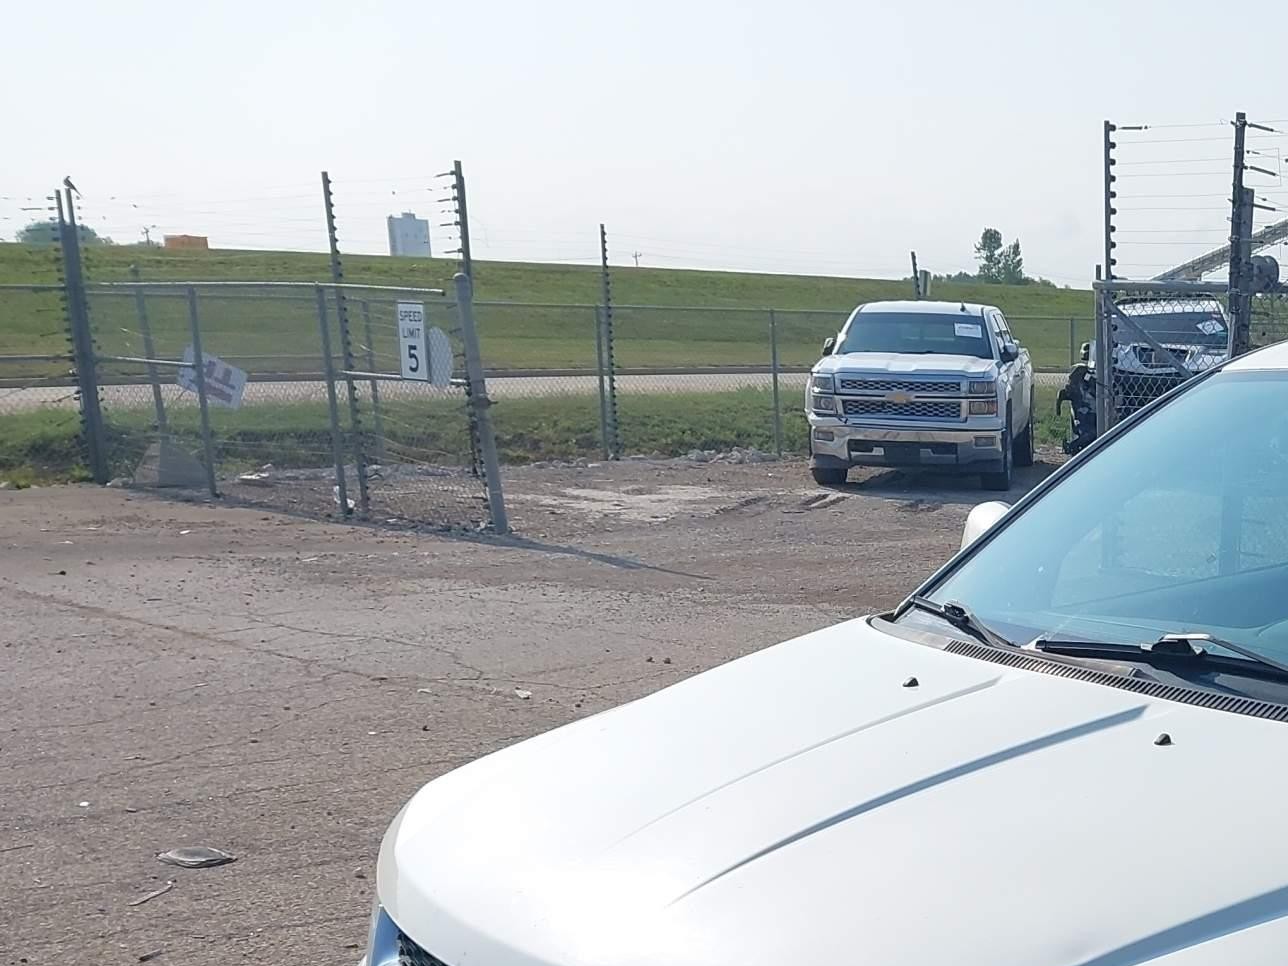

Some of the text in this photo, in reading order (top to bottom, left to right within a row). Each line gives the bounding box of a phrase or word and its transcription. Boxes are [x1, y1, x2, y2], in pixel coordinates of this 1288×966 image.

[399, 310, 422, 322] SPEED
[401, 327, 420, 338] LIMIT
[407, 344, 419, 373] 5
